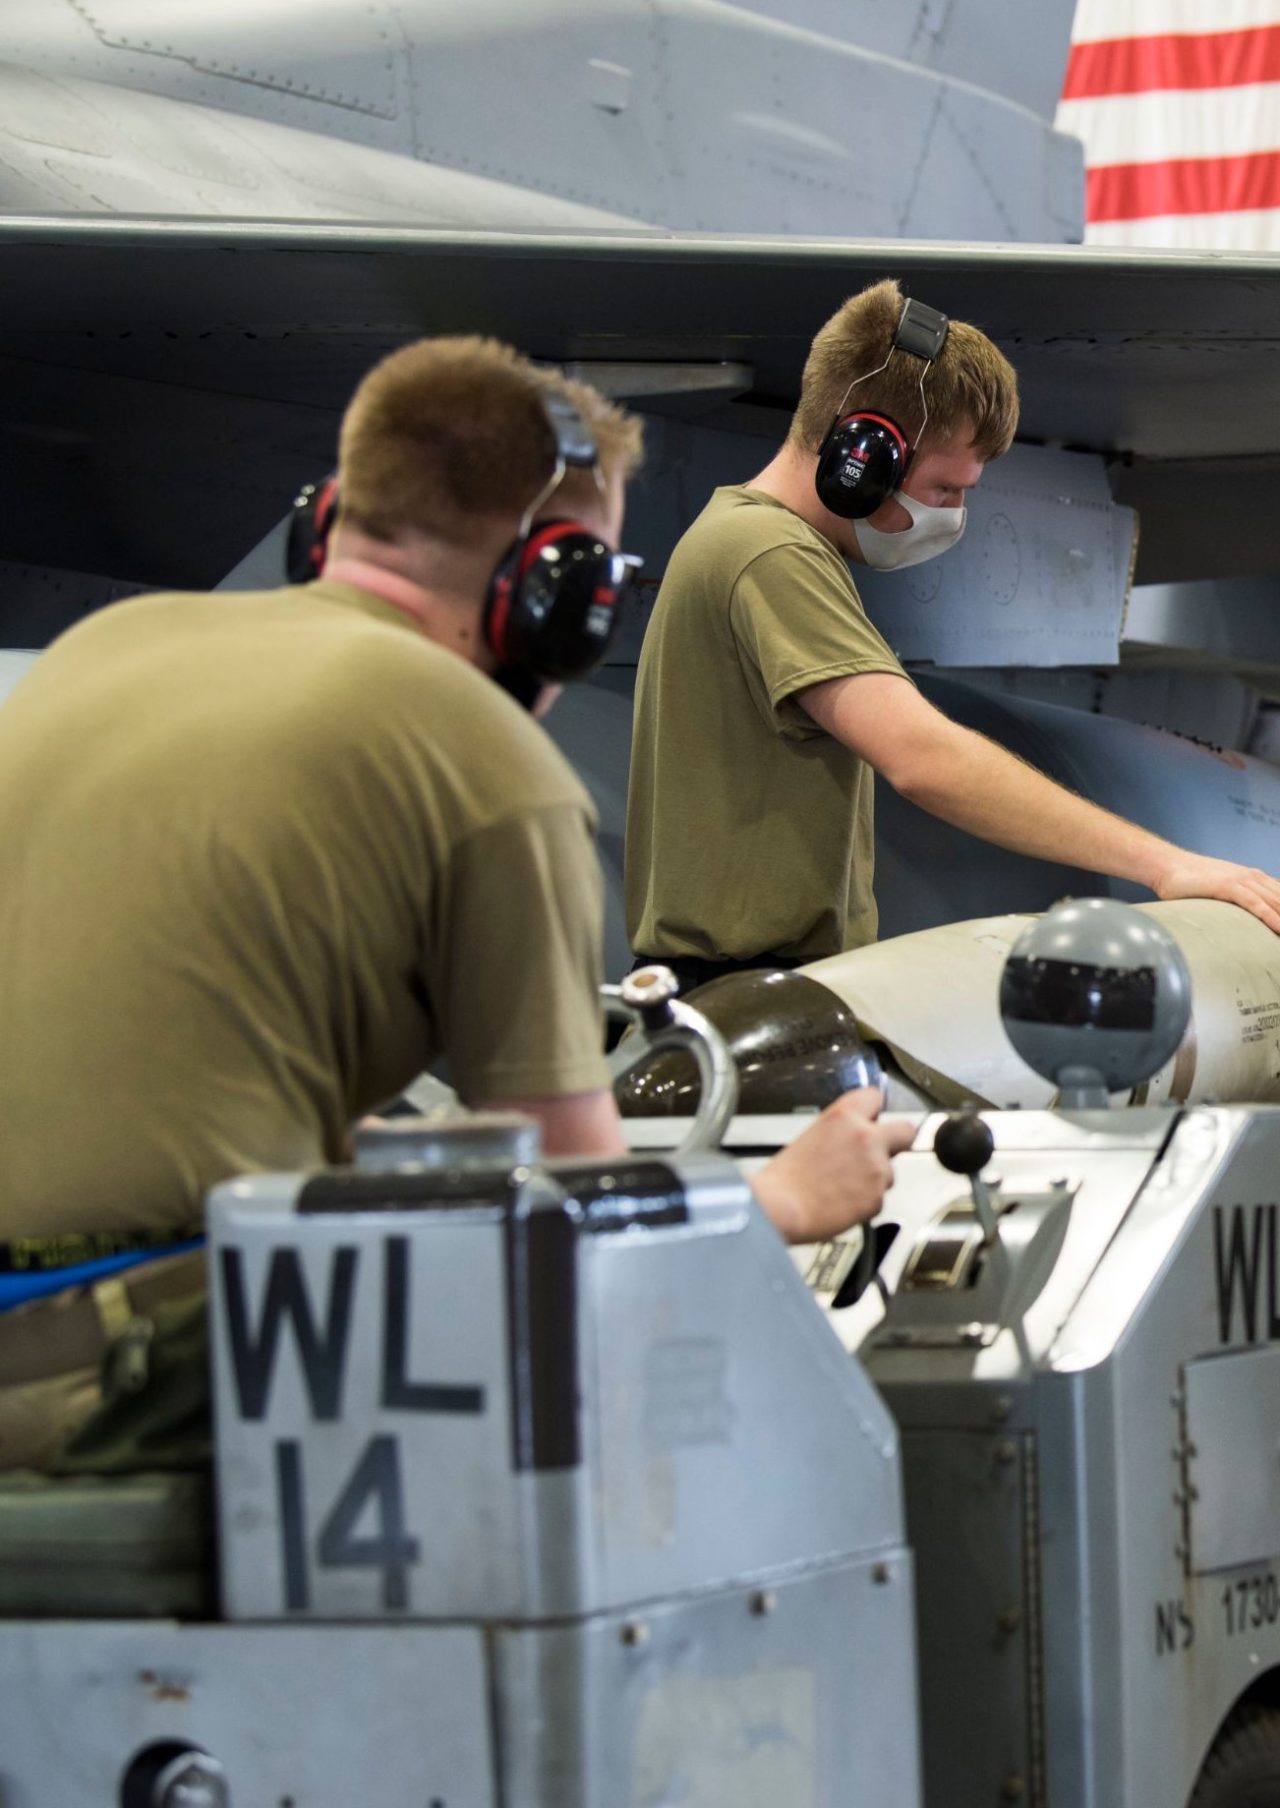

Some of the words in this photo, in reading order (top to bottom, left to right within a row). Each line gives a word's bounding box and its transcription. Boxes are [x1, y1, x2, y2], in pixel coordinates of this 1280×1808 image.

[844, 465, 861, 479] 105
[219, 1234, 487, 1424] WL
[274, 1434, 421, 1612] 14
